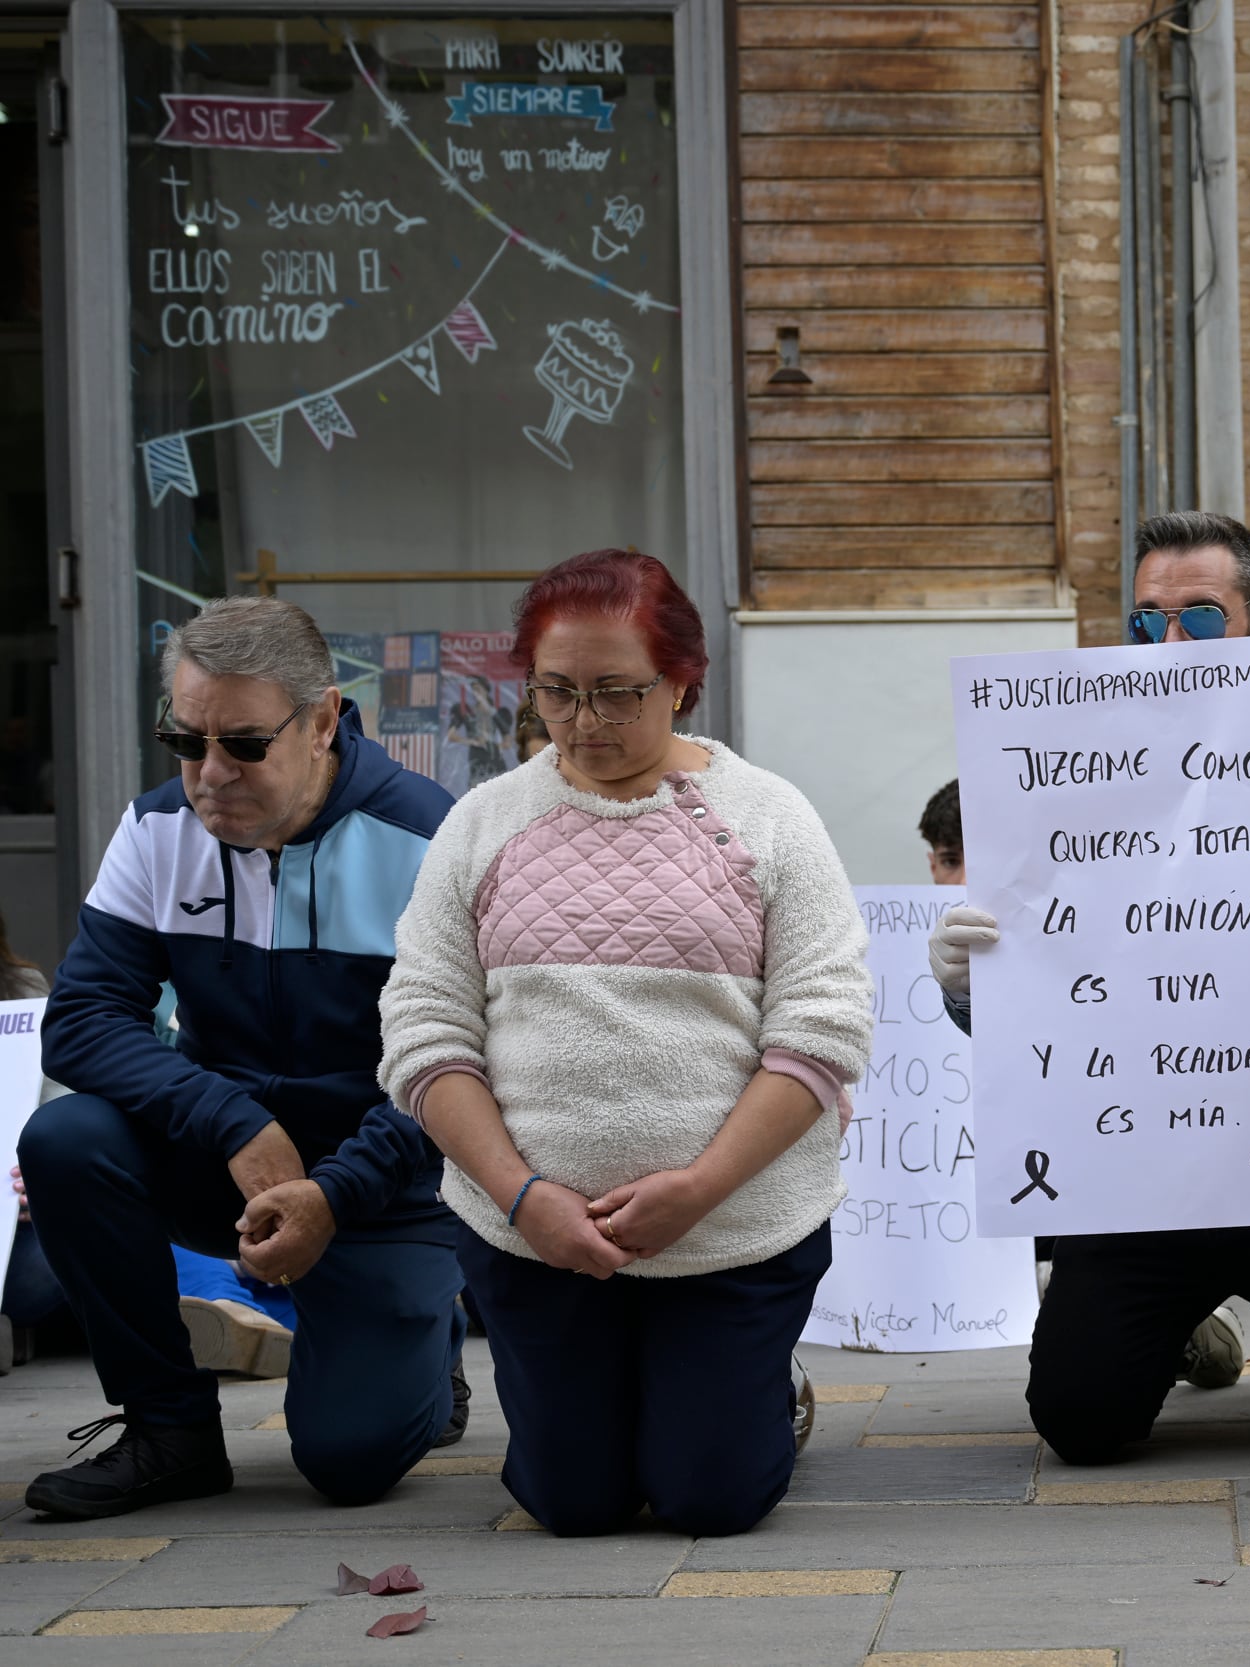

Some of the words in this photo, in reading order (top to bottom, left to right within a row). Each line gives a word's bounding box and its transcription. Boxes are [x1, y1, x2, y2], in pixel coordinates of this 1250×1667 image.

[445, 34, 501, 69] PARA
[472, 85, 583, 114] SIEMPRE
[190, 105, 293, 142] SIGUE
[447, 137, 487, 182] hay
[501, 149, 533, 172] un
[538, 137, 611, 172] motivo
[161, 165, 240, 229] tus
[267, 189, 427, 233] sueños
[150, 248, 231, 295] ELLOS
[261, 249, 337, 295] SABEN
[359, 248, 389, 293] EL
[1001, 747, 1150, 792] JUZGAME
[1050, 830, 1176, 863] QUIERAS,
[1043, 897, 1076, 934] LA
[872, 975, 945, 1024] LO
[1071, 974, 1108, 1004] ES
[1147, 973, 1220, 1003] TUYA
[855, 1053, 970, 1104] MOS
[1032, 1044, 1052, 1079] Y
[1086, 1047, 1114, 1078] LA
[1097, 1105, 1134, 1134] ES
[1169, 1099, 1240, 1130] MÍA.
[932, 1301, 1009, 1341] Manuel
